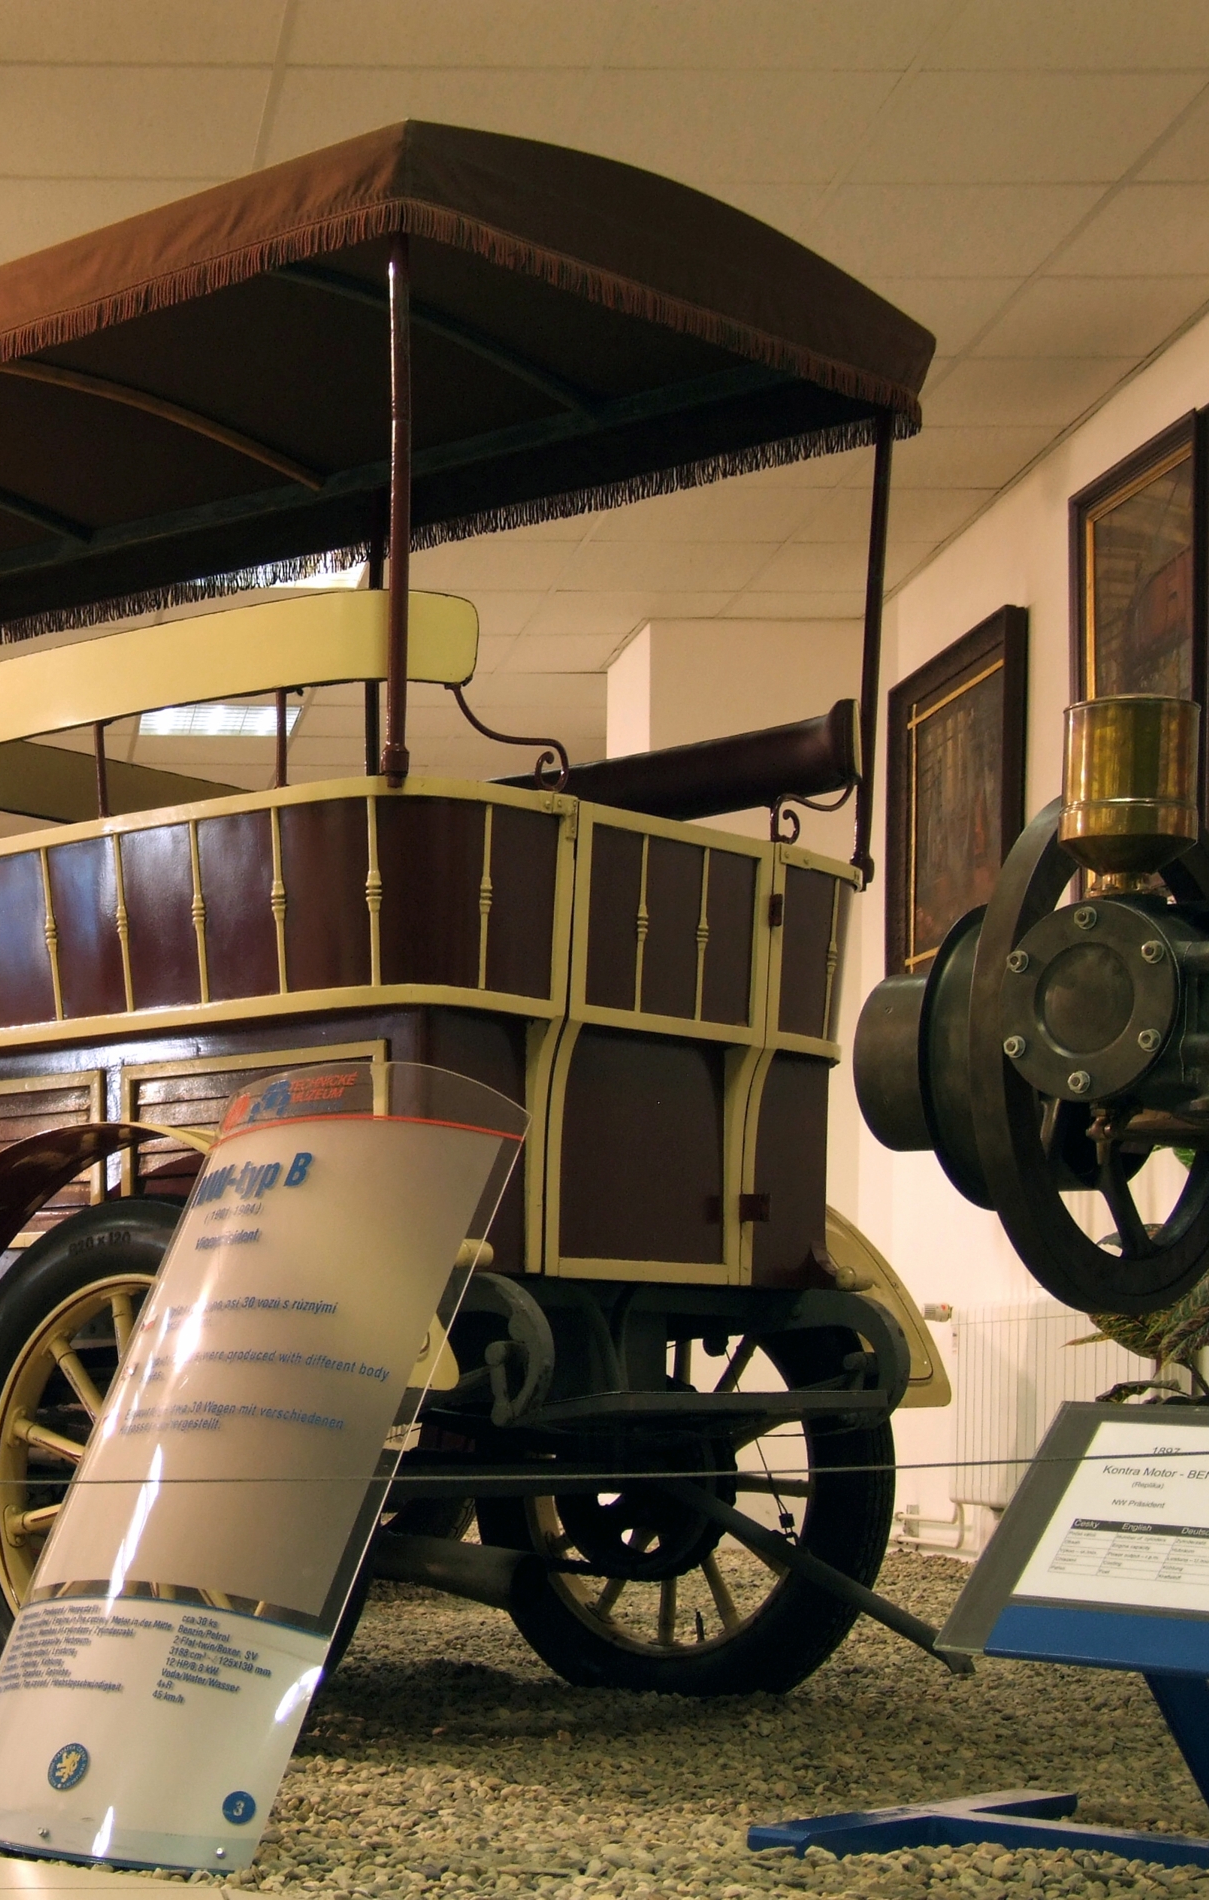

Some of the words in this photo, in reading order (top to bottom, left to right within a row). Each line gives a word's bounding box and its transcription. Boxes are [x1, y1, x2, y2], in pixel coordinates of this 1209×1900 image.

[283, 1152, 312, 1187] B
[242, 1297, 255, 1308] 30
[282, 1299, 289, 1309] s
[291, 1299, 338, 1315] různými
[226, 1349, 277, 1363] produced
[279, 1352, 302, 1363] with
[305, 1354, 356, 1372] different
[359, 1362, 389, 1382] body
[204, 1401, 236, 1416] Wagen
[239, 1403, 257, 1416] mit
[260, 1408, 344, 1430] verschiedenen
[1103, 1465, 1140, 1476] Kontra
[1143, 1468, 1177, 1478] Motor
[1121, 1522, 1152, 1532] English
[244, 1650, 259, 1661] SV
[161, 1668, 240, 1692] Voda/Water/Wasser
[254, 1667, 271, 1677] mm
[152, 1690, 163, 1700] 45
[163, 1691, 185, 1704] km/h
[233, 1800, 245, 1817] 3
